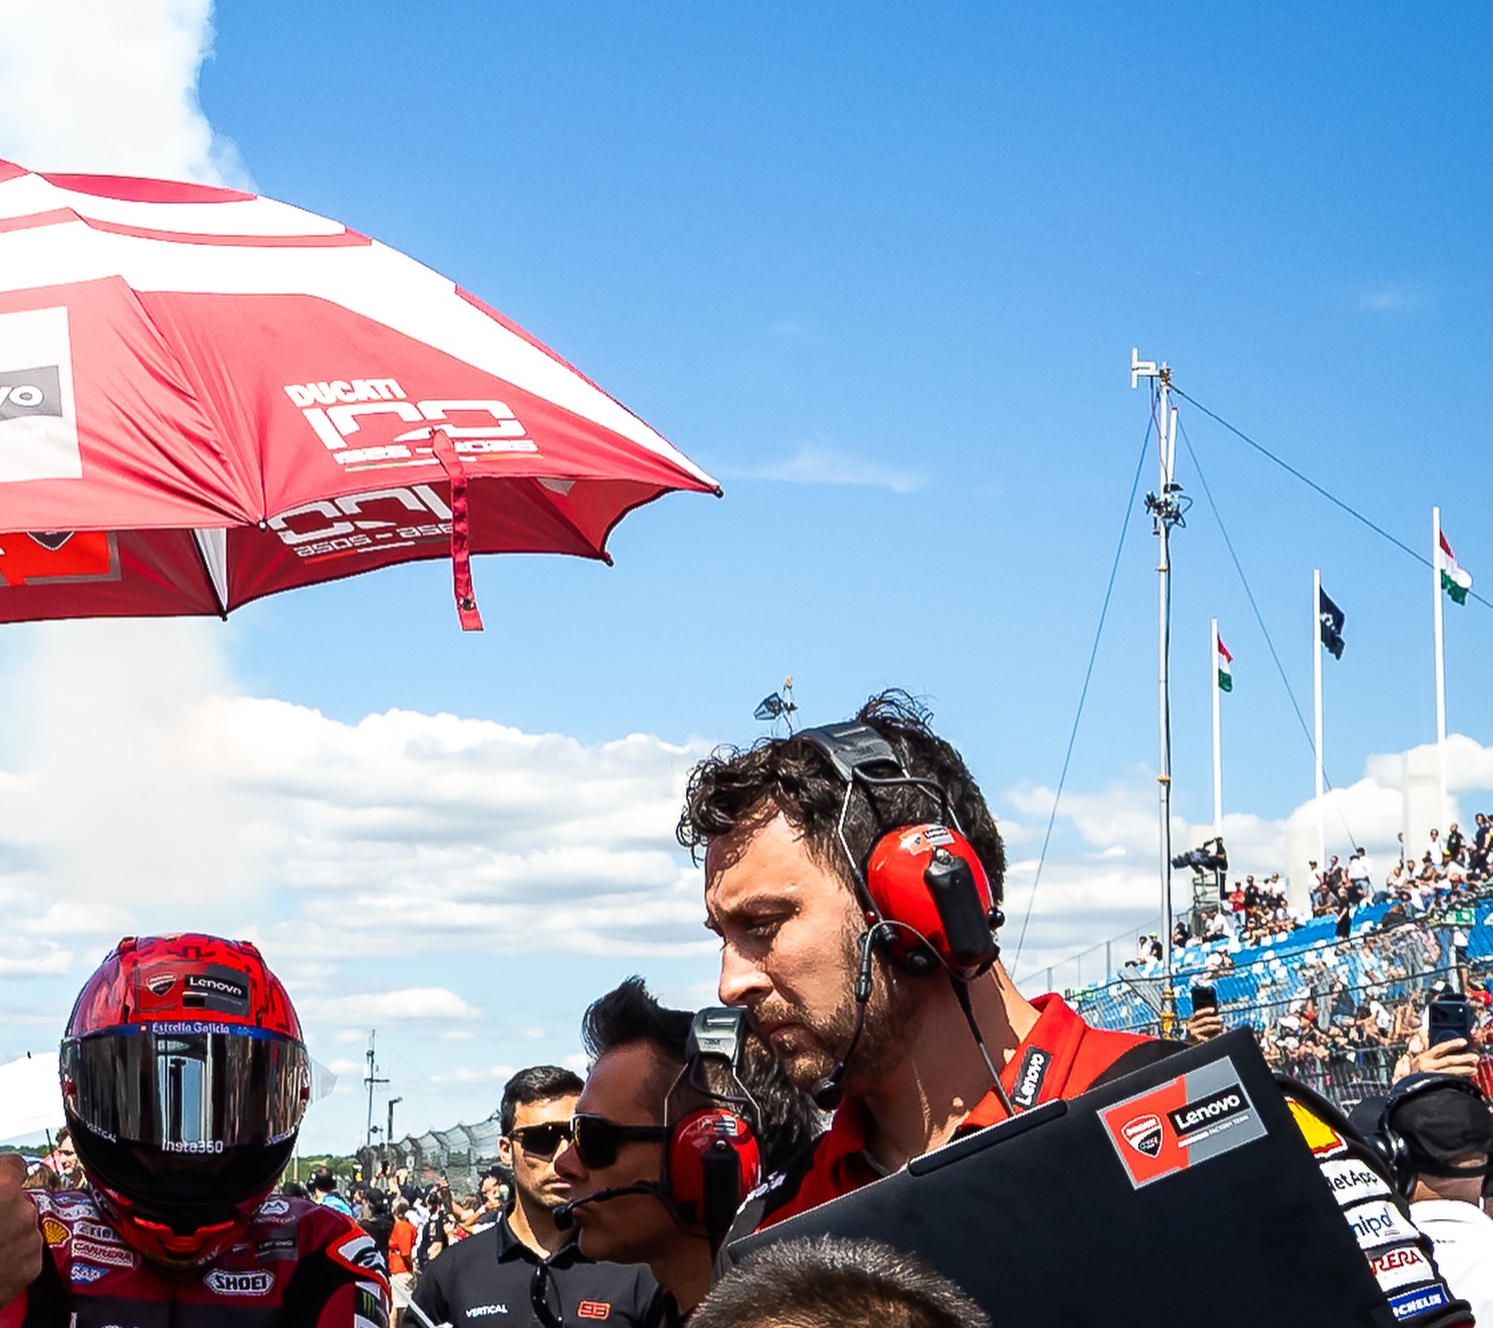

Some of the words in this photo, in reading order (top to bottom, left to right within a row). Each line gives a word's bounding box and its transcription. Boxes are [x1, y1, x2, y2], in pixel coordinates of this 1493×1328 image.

[284, 378, 408, 407] DUCATI
[152, 1021, 193, 1034] Estrella
[194, 1021, 230, 1035] Galicia
[1016, 1053, 1045, 1106] Lenovo
[1174, 1095, 1241, 1130] Lenovo
[1351, 1207, 1395, 1237] nipol
[214, 1273, 269, 1292] SHOEI
[466, 1304, 508, 1318] VERTICAL
